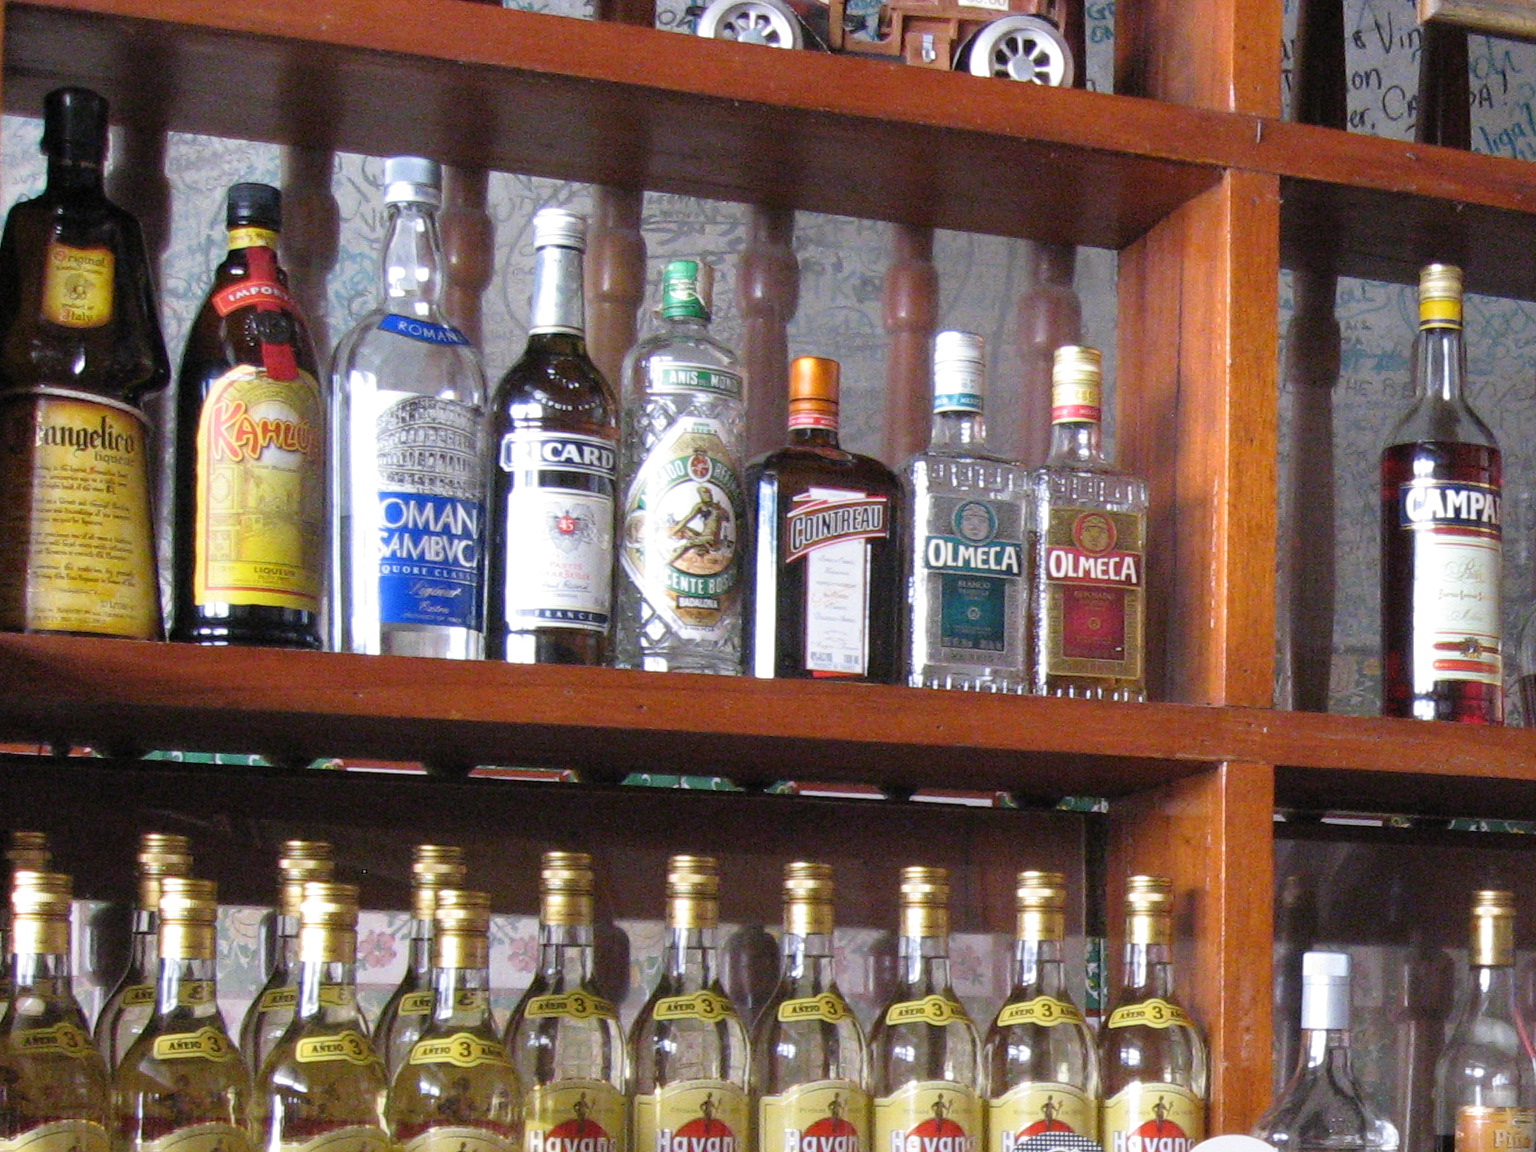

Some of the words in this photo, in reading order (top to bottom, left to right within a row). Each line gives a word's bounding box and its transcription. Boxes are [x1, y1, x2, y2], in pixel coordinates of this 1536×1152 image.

[398, 319, 459, 343] ROMAN
[668, 369, 699, 386] ANIS
[37, 416, 135, 453] angelico
[512, 442, 614, 469] RICARD
[379, 498, 478, 538] OMAN
[558, 519, 574, 532] 45
[790, 504, 882, 552] COINTREAU
[927, 538, 1019, 574] OLMECA
[1049, 549, 1138, 583] OLMECA
[573, 998, 585, 1014] 3
[666, 1001, 695, 1013] AÑEJO
[701, 999, 714, 1014] 3
[791, 1002, 820, 1014] AÑEJO
[827, 1000, 838, 1015] 3
[897, 1008, 925, 1017] AÑEJO
[932, 1003, 944, 1018] 3
[1008, 1008, 1035, 1018] AÑEJO
[1041, 1003, 1053, 1018] 3
[1118, 1010, 1145, 1020] AÑEJO
[1152, 1005, 1164, 1021] 3
[64, 1030, 78, 1048] 3
[167, 1038, 202, 1051] AÑEJO
[209, 1036, 222, 1053] 3
[311, 1041, 344, 1054] AÑEJO
[349, 1037, 363, 1056] 3
[421, 1043, 451, 1056] AÑEJO
[458, 1041, 472, 1058] 3
